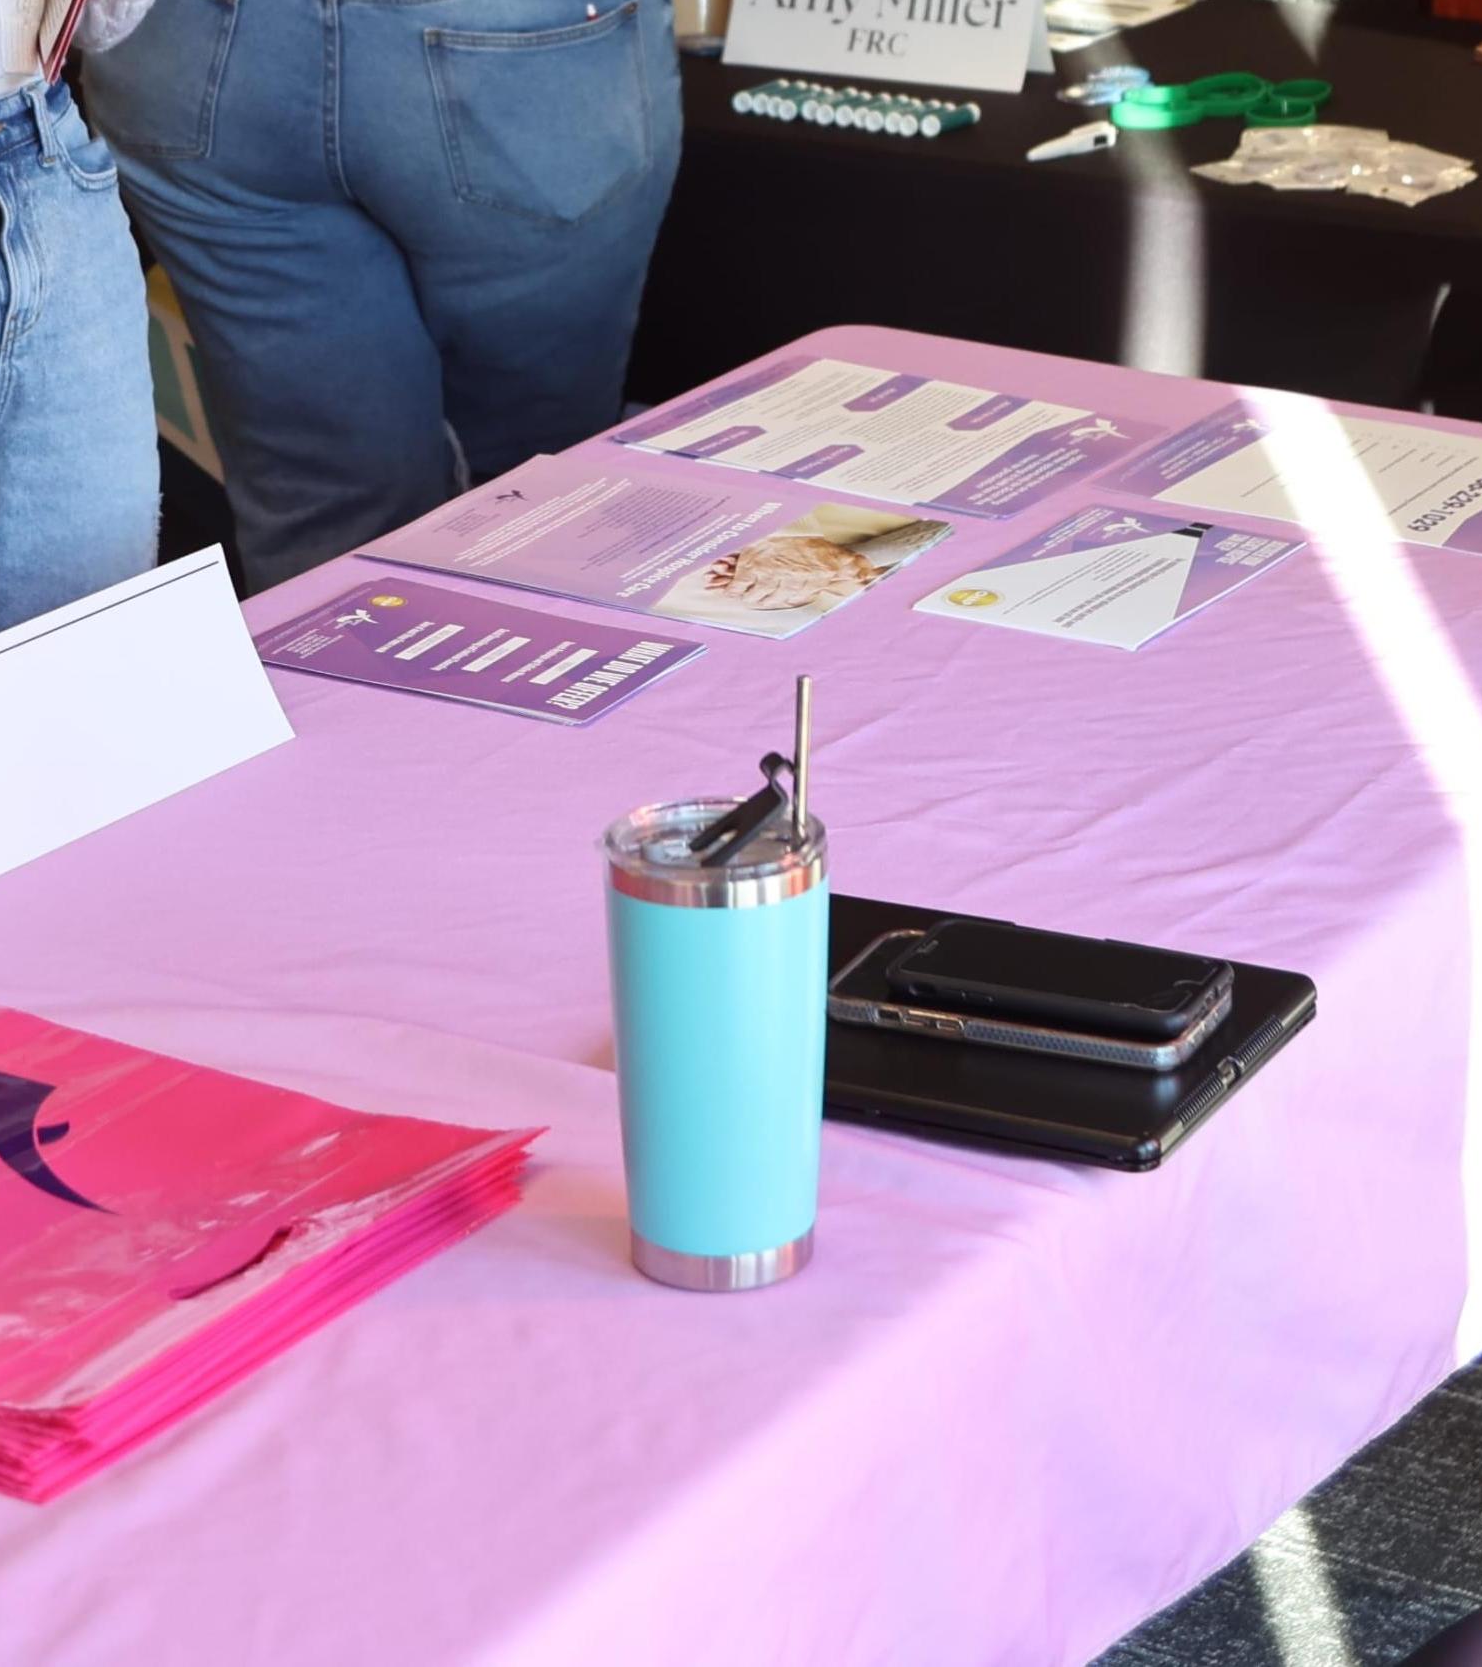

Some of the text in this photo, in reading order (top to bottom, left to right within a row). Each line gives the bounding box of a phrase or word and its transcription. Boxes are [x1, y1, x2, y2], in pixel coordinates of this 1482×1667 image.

[847, 27, 908, 56] FRC
[616, 502, 782, 598] When to Consider Hospice Care
[618, 640, 675, 664] WHAT
[581, 669, 629, 686] WE
[602, 660, 644, 674] DO
[545, 682, 610, 710] OFFER?
